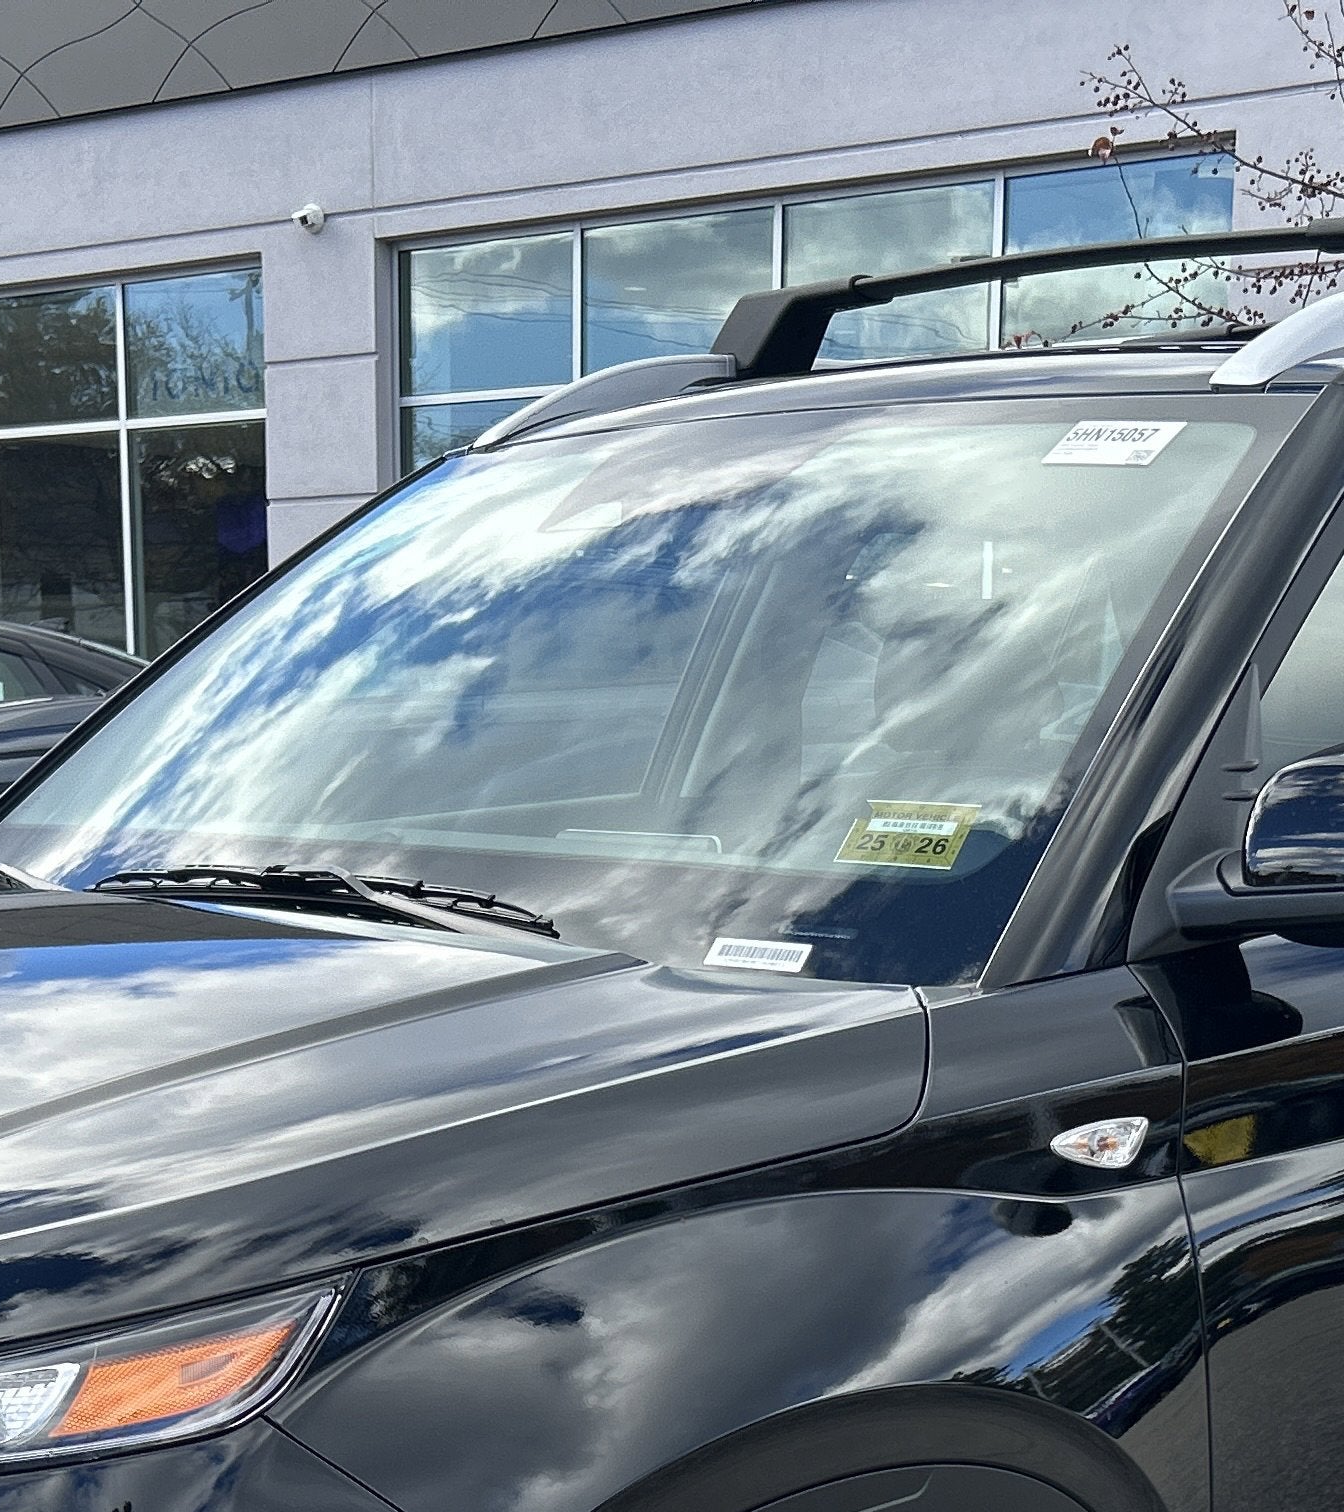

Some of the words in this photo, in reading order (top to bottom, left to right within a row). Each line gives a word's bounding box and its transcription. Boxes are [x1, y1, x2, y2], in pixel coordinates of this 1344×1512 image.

[1066, 428, 1160, 442] 5HN15057
[857, 834, 888, 851] 25
[915, 837, 949, 855] 26
